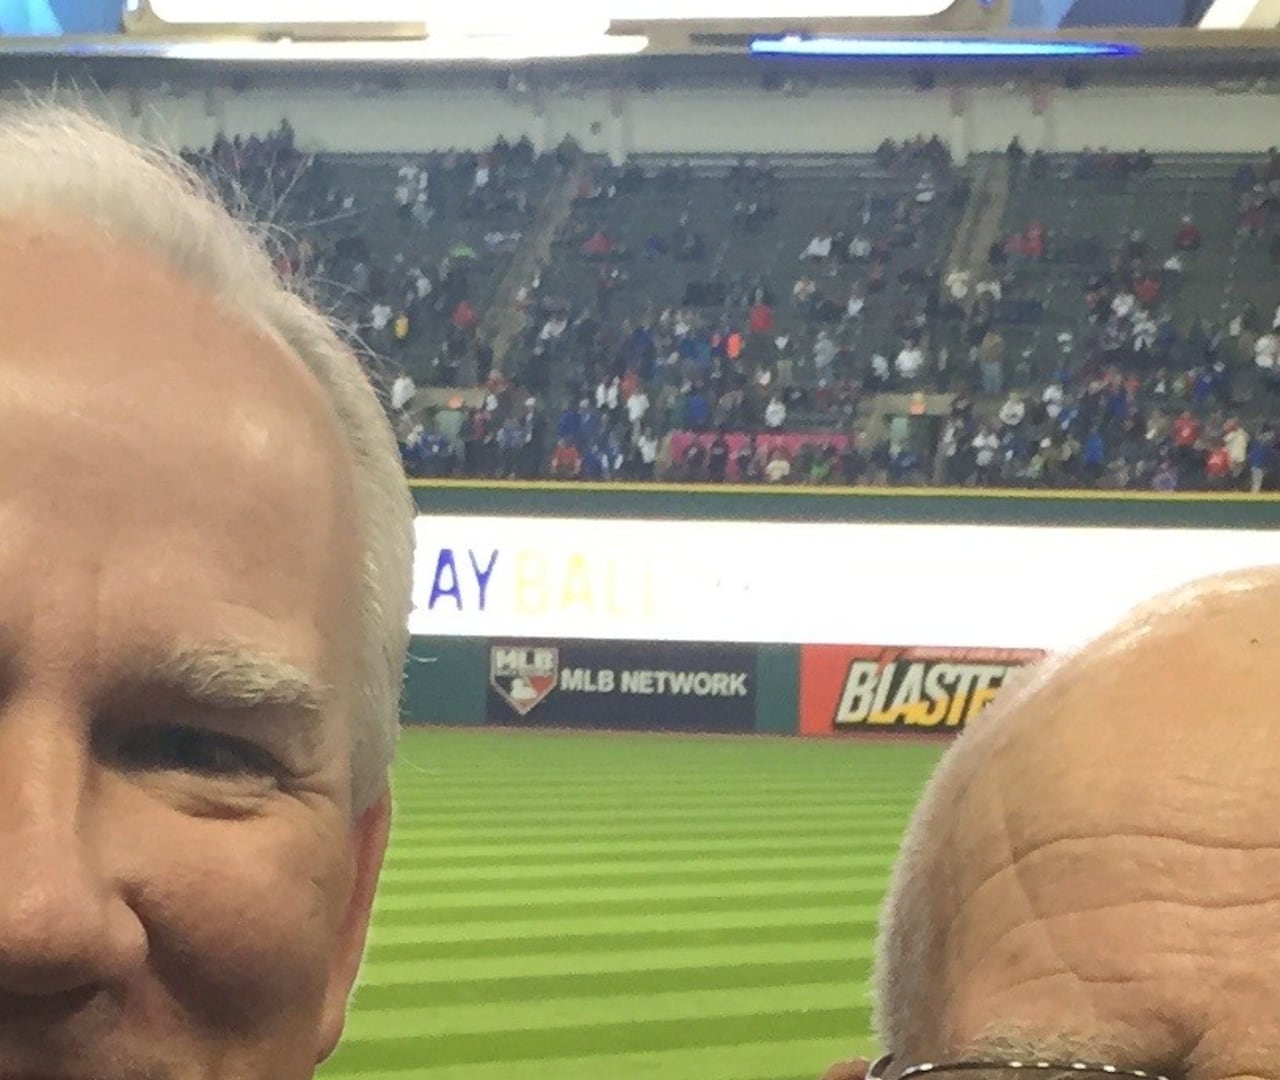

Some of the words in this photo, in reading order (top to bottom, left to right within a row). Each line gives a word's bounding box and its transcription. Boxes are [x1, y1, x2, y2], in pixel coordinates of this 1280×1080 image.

[495, 649, 554, 671] MLB
[560, 667, 614, 693] MLB
[620, 669, 747, 698] NETWORK
[835, 661, 1022, 728] BLASTE
